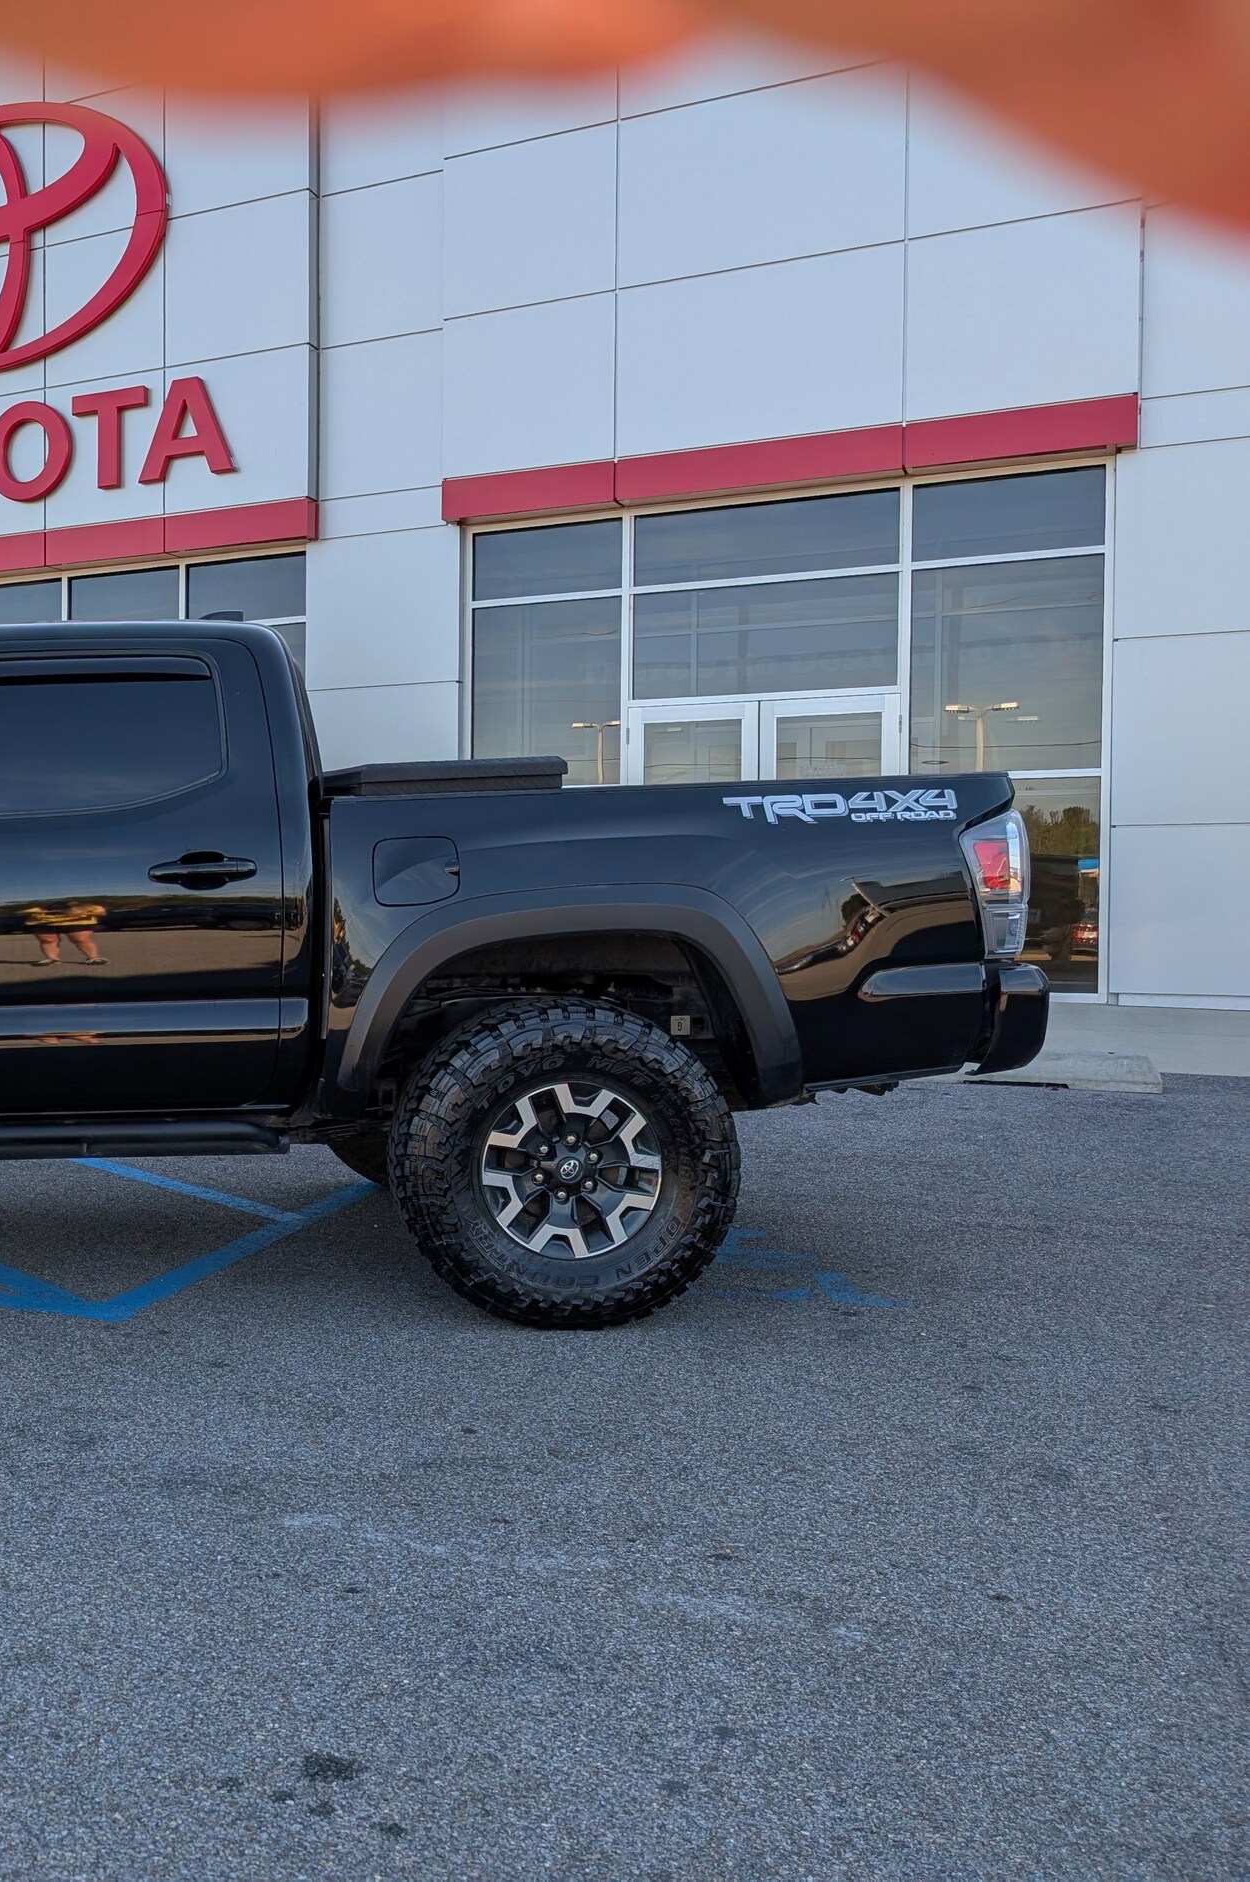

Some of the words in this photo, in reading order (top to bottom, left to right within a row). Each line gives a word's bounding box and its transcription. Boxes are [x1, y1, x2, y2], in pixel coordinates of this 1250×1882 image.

[722, 793, 849, 824] TRD
[851, 811, 894, 822] OFF
[897, 810, 956, 822] ROAD
[476, 1056, 565, 1110] TOYO
[587, 1055, 652, 1086] M/T
[466, 1219, 599, 1289] COUNTRY
[615, 1216, 682, 1281] OPEN
